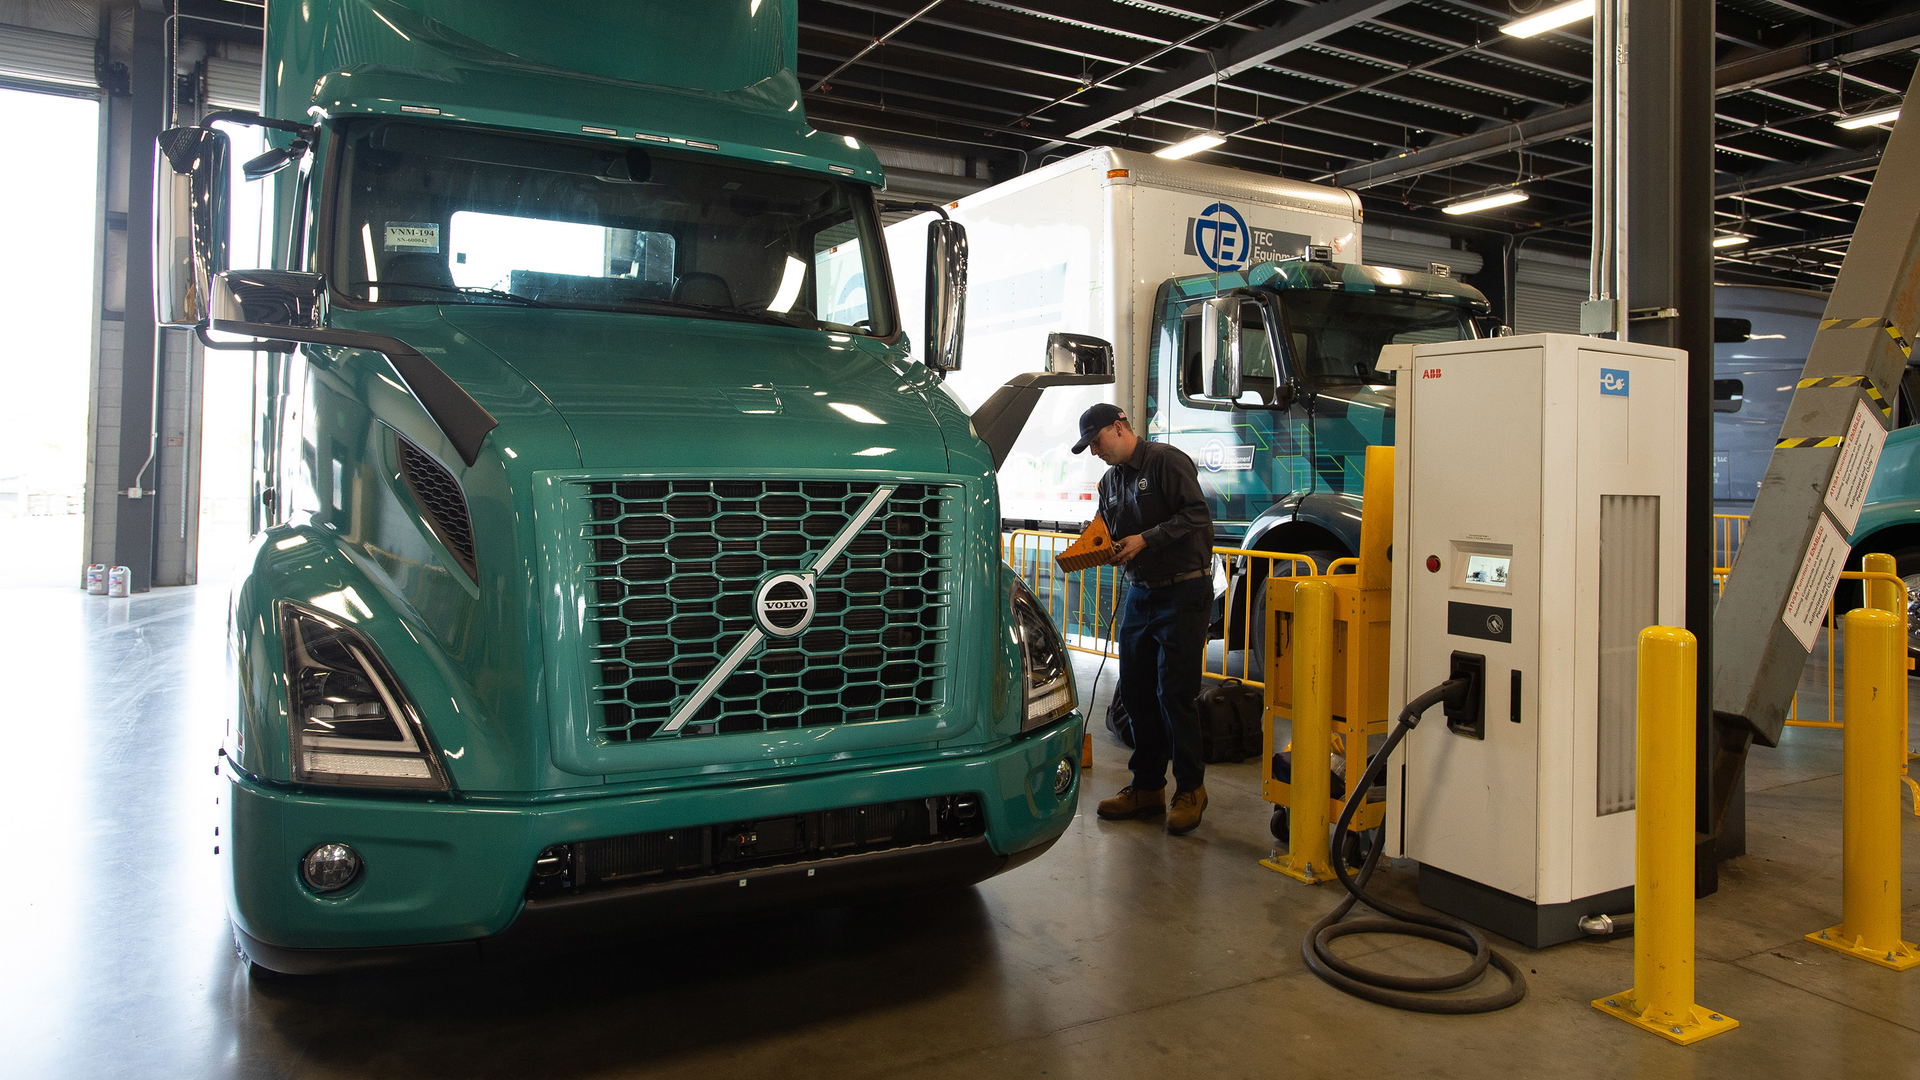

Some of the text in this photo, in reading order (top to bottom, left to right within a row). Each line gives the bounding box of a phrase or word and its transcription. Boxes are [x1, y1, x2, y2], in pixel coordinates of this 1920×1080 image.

[390, 228, 434, 237] VNM-194
[1253, 231, 1274, 247] TEC
[1253, 245, 1295, 262] Equipm
[1422, 368, 1442, 380] ABB
[1837, 449, 1848, 475] Function
[1849, 412, 1861, 442] ENABLED
[1850, 478, 1862, 509] Authorized
[1864, 445, 1873, 465] Trained
[1856, 473, 1868, 502] Personnel
[1788, 592, 1798, 613] ATVSA
[1797, 564, 1809, 591] Function
[1810, 526, 1823, 557] ENABLED
[765, 601, 808, 609] VOLVO
[1809, 593, 1822, 626] Authorized
[1825, 559, 1835, 580] Trained
[1816, 588, 1828, 618] Personnel
